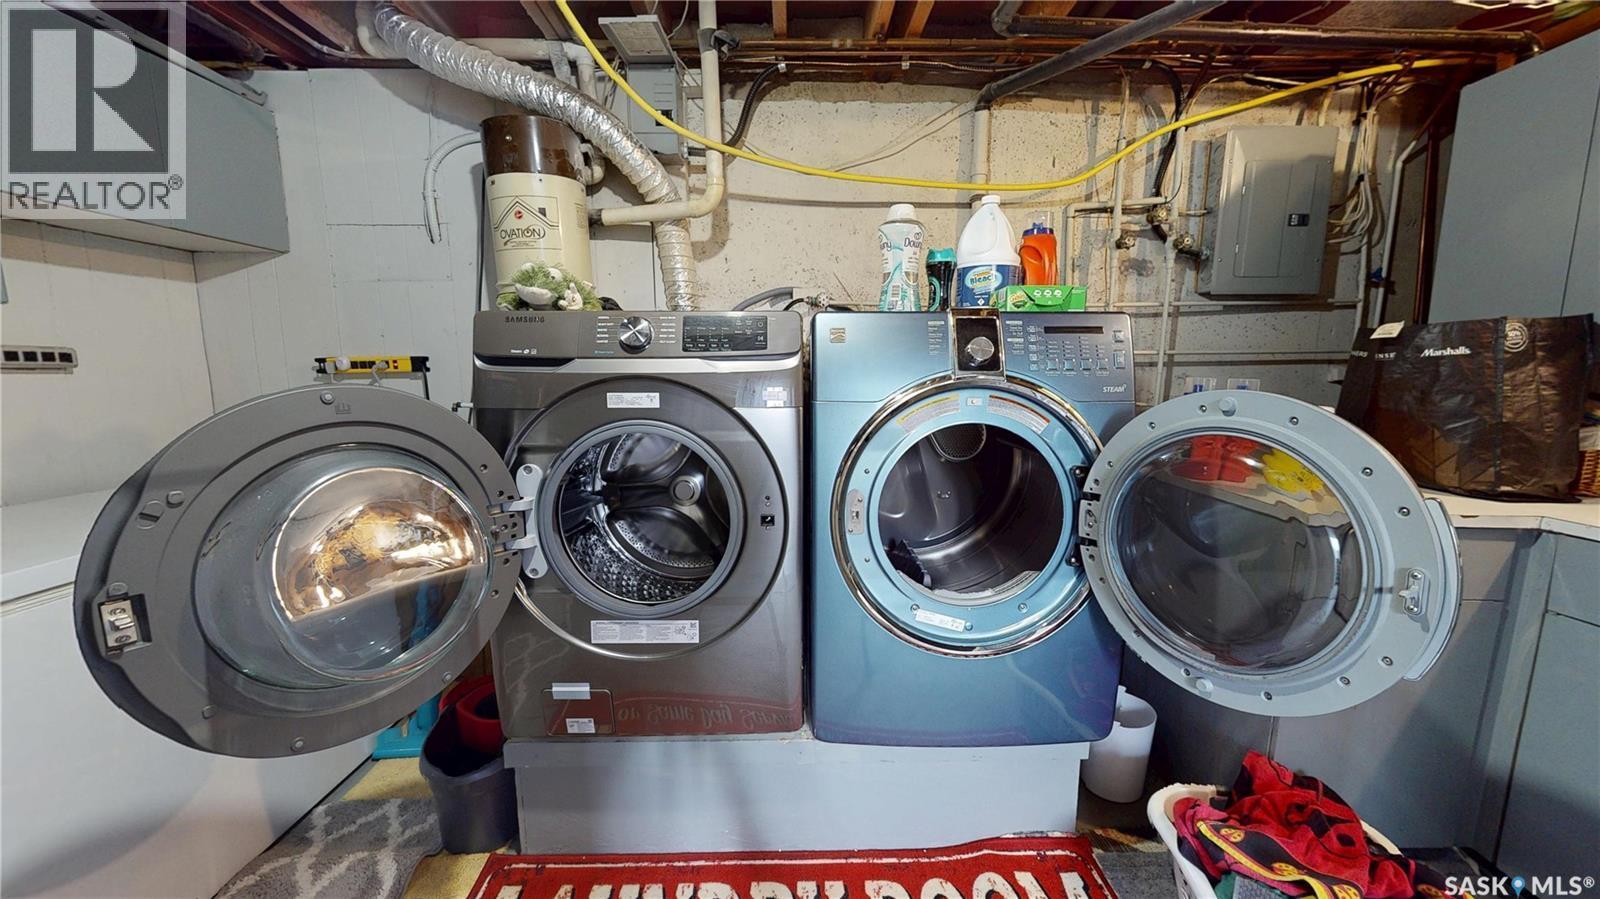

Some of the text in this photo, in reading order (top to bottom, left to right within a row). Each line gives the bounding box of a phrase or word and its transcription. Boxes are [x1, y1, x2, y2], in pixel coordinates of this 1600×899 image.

[500, 226, 545, 240] OVATION
[504, 315, 545, 323] SAMSUNG
[1420, 346, 1471, 358] Marshalls
